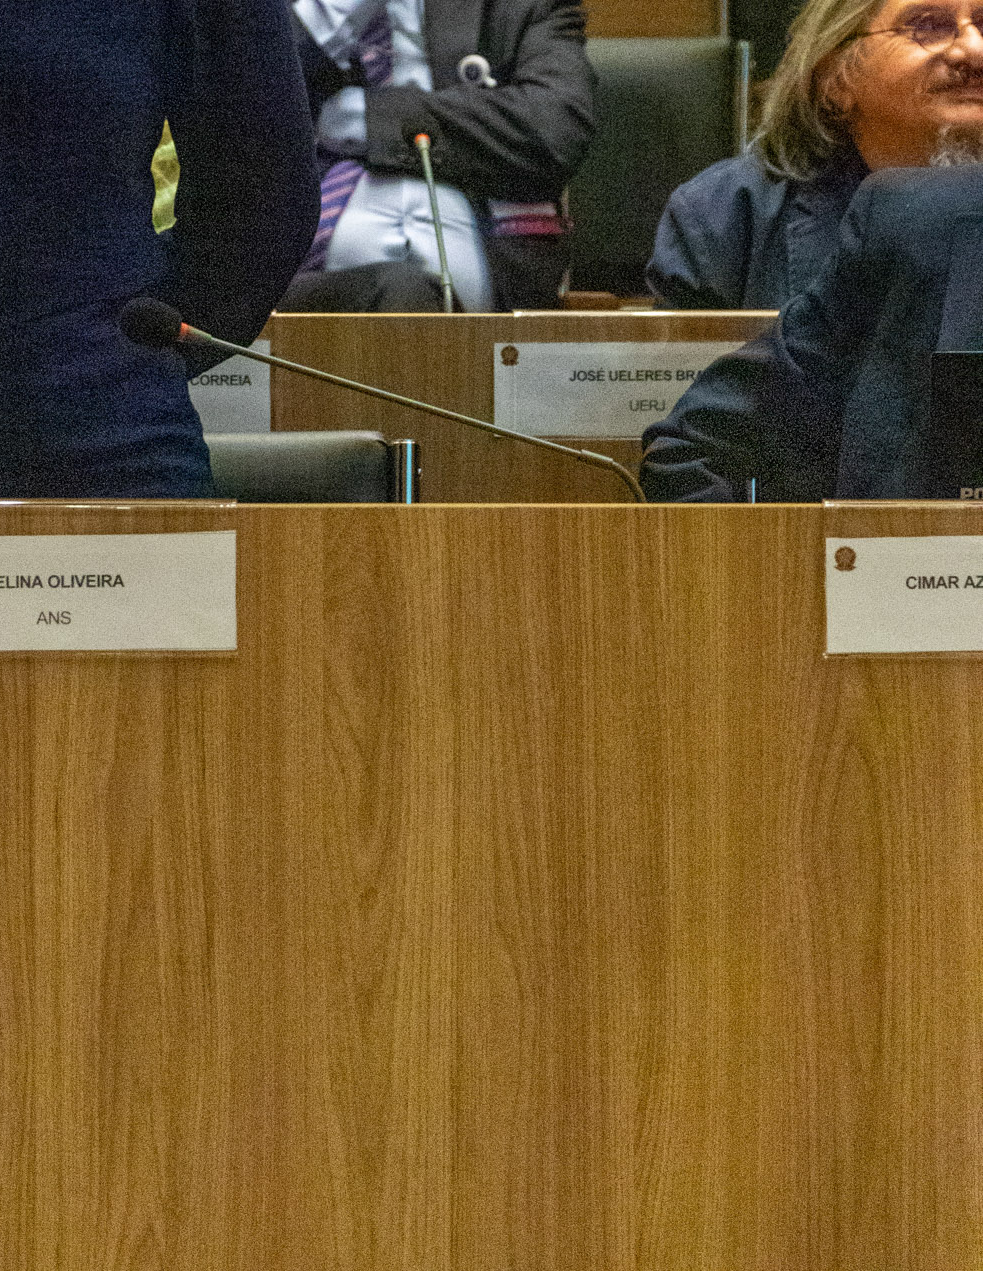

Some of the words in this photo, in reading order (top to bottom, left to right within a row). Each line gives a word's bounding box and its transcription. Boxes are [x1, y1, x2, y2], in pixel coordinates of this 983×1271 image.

[190, 374, 252, 387] CORREIA
[570, 368, 604, 381] JOSÉ
[608, 369, 672, 382] UELERES
[676, 369, 702, 381] BR
[629, 399, 666, 412] UERJ
[48, 574, 124, 588] OLIVEIRA
[905, 576, 959, 590] CIMAR
[36, 611, 72, 625] ANS
